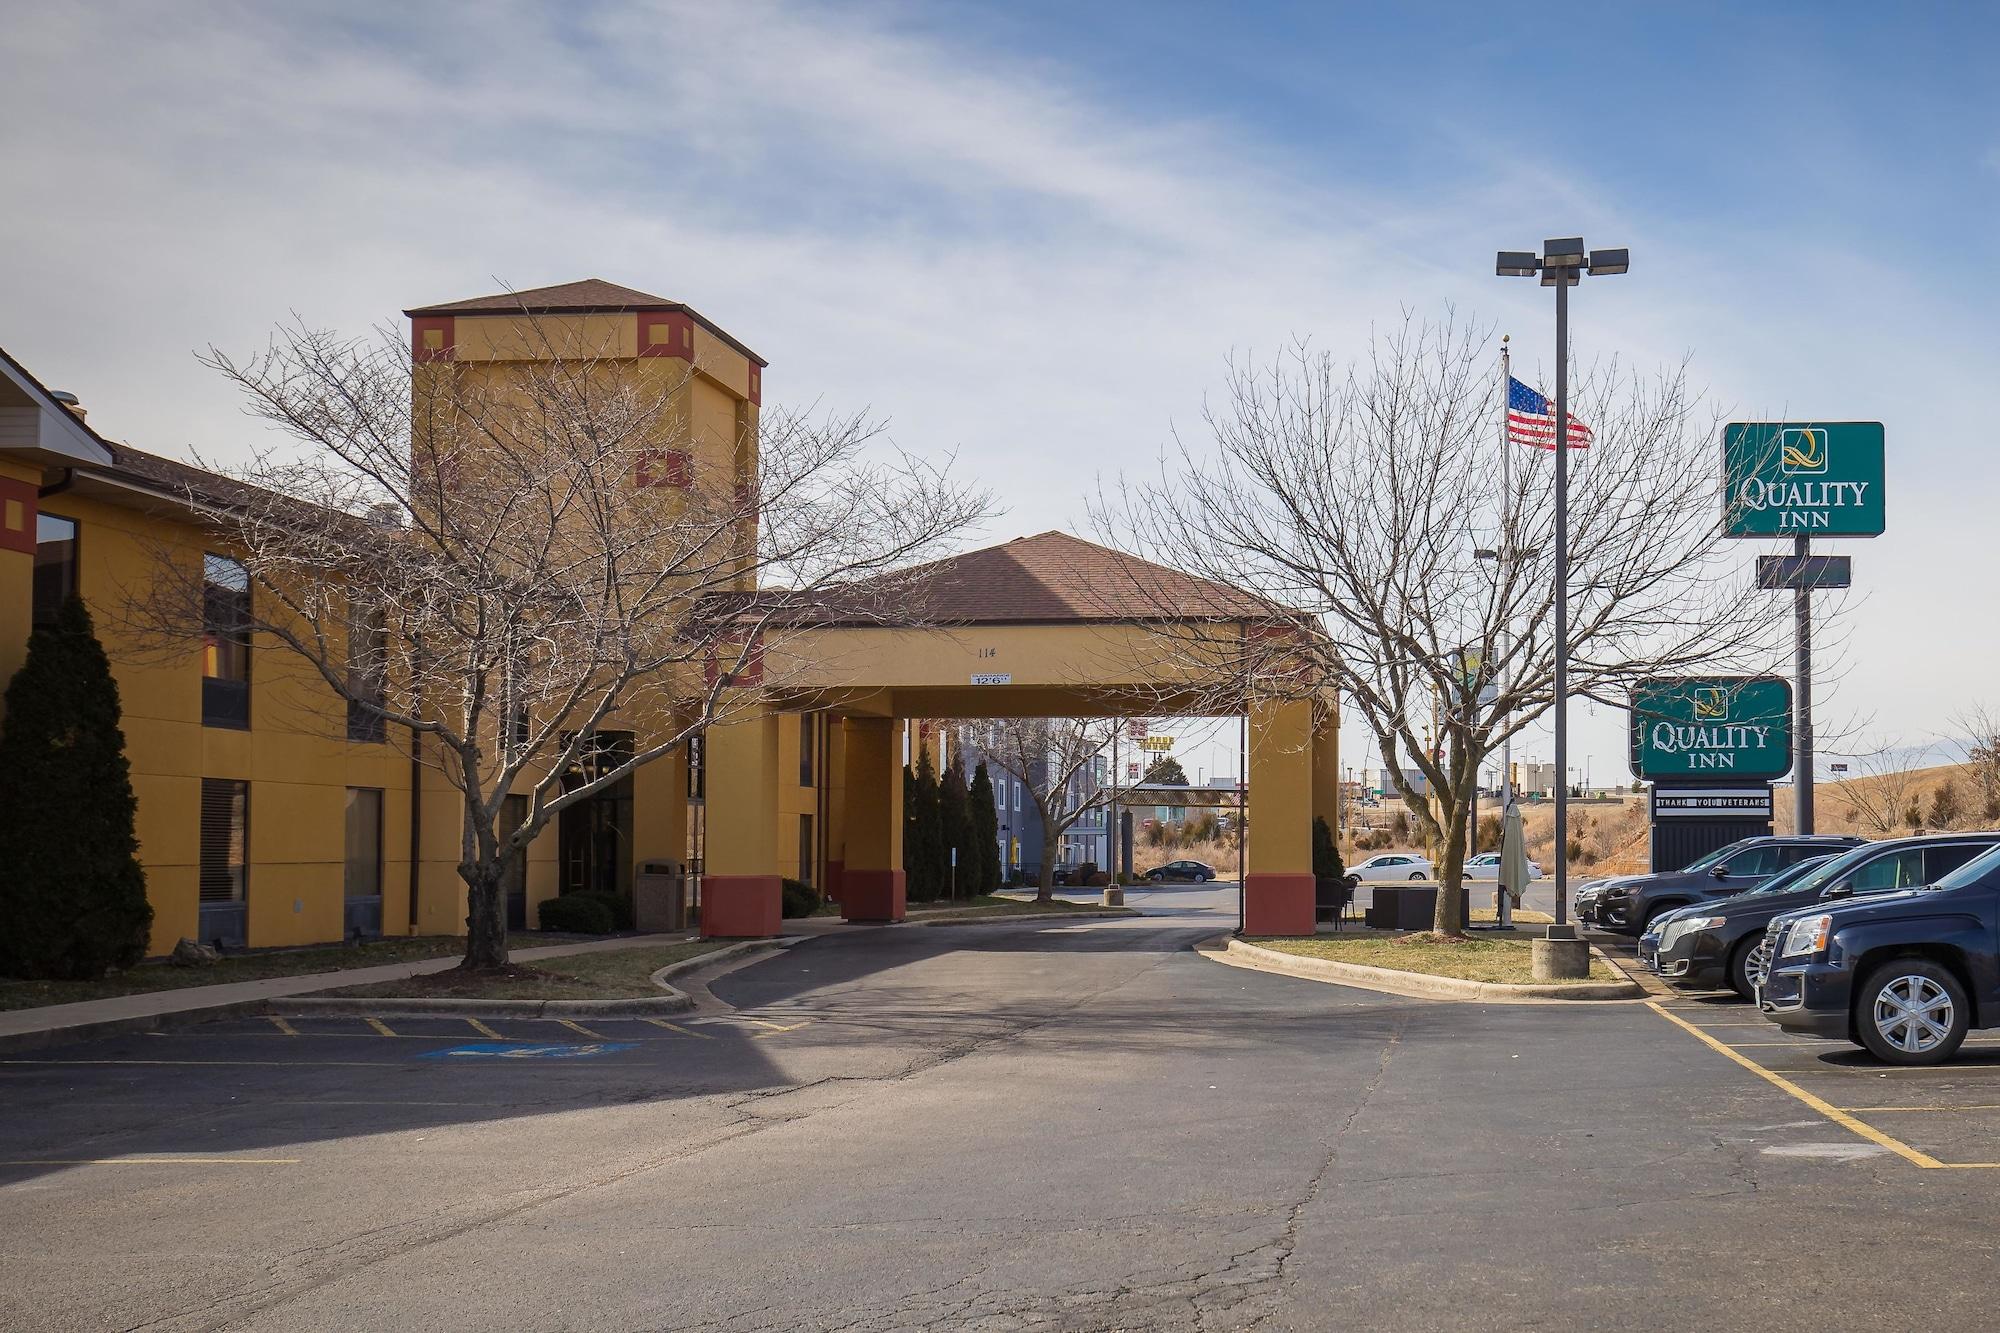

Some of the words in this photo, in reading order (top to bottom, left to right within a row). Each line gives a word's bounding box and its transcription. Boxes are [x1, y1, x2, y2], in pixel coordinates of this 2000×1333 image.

[1741, 477, 1869, 511] QUALITY
[1779, 511, 1830, 528] INN
[979, 648, 996, 658] 114
[1652, 721, 1769, 753] QUALITY
[1688, 752, 1735, 769] INN
[1660, 798, 1687, 806] THANK
[1696, 798, 1717, 806] YOU
[1722, 798, 1766, 806] VETERANS
